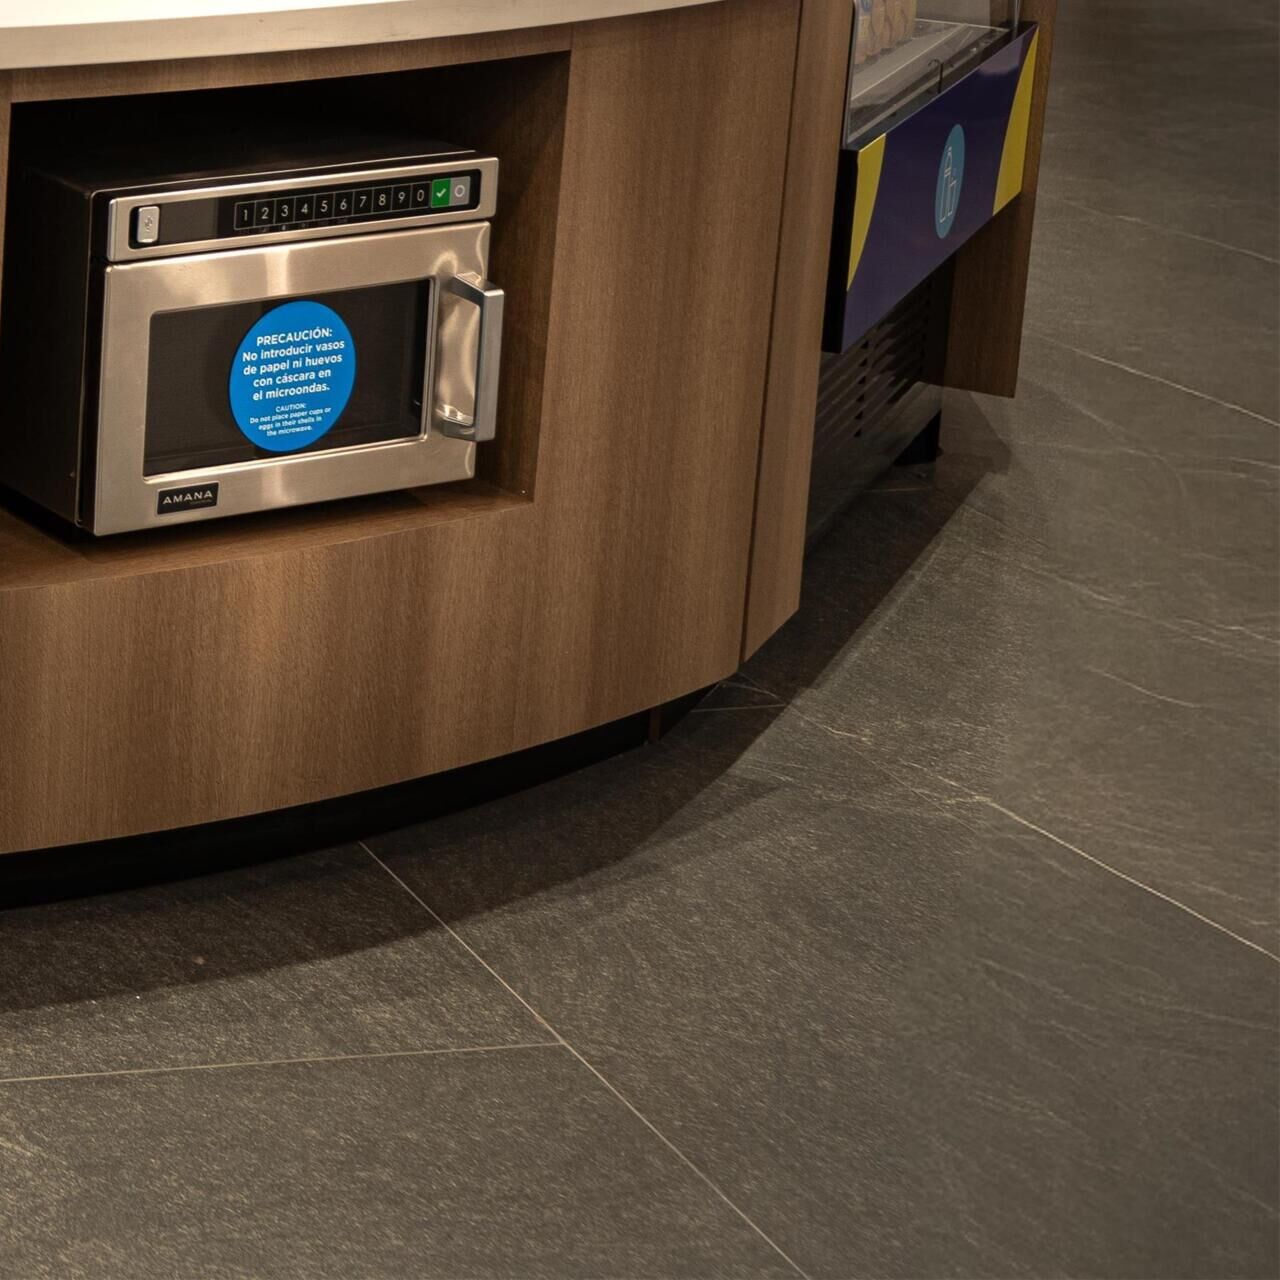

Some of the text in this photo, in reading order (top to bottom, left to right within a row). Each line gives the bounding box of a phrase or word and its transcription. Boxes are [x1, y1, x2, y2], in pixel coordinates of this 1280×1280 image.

[243, 190, 424, 221] 1 2 3 4 5 6 7 8 9 0
[257, 326, 332, 346] PRECAUCIÓN:
[242, 340, 344, 362] No introducir vasos
[244, 354, 343, 375] de papel ni huevos
[253, 369, 331, 387] con cáscara en
[253, 383, 330, 400] el microondas.
[272, 414, 288, 422] place
[290, 411, 307, 420] paper
[309, 409, 323, 418] cups
[276, 403, 306, 412] CAUTION:
[278, 427, 312, 435] microwave.
[163, 490, 213, 504] AMANA
